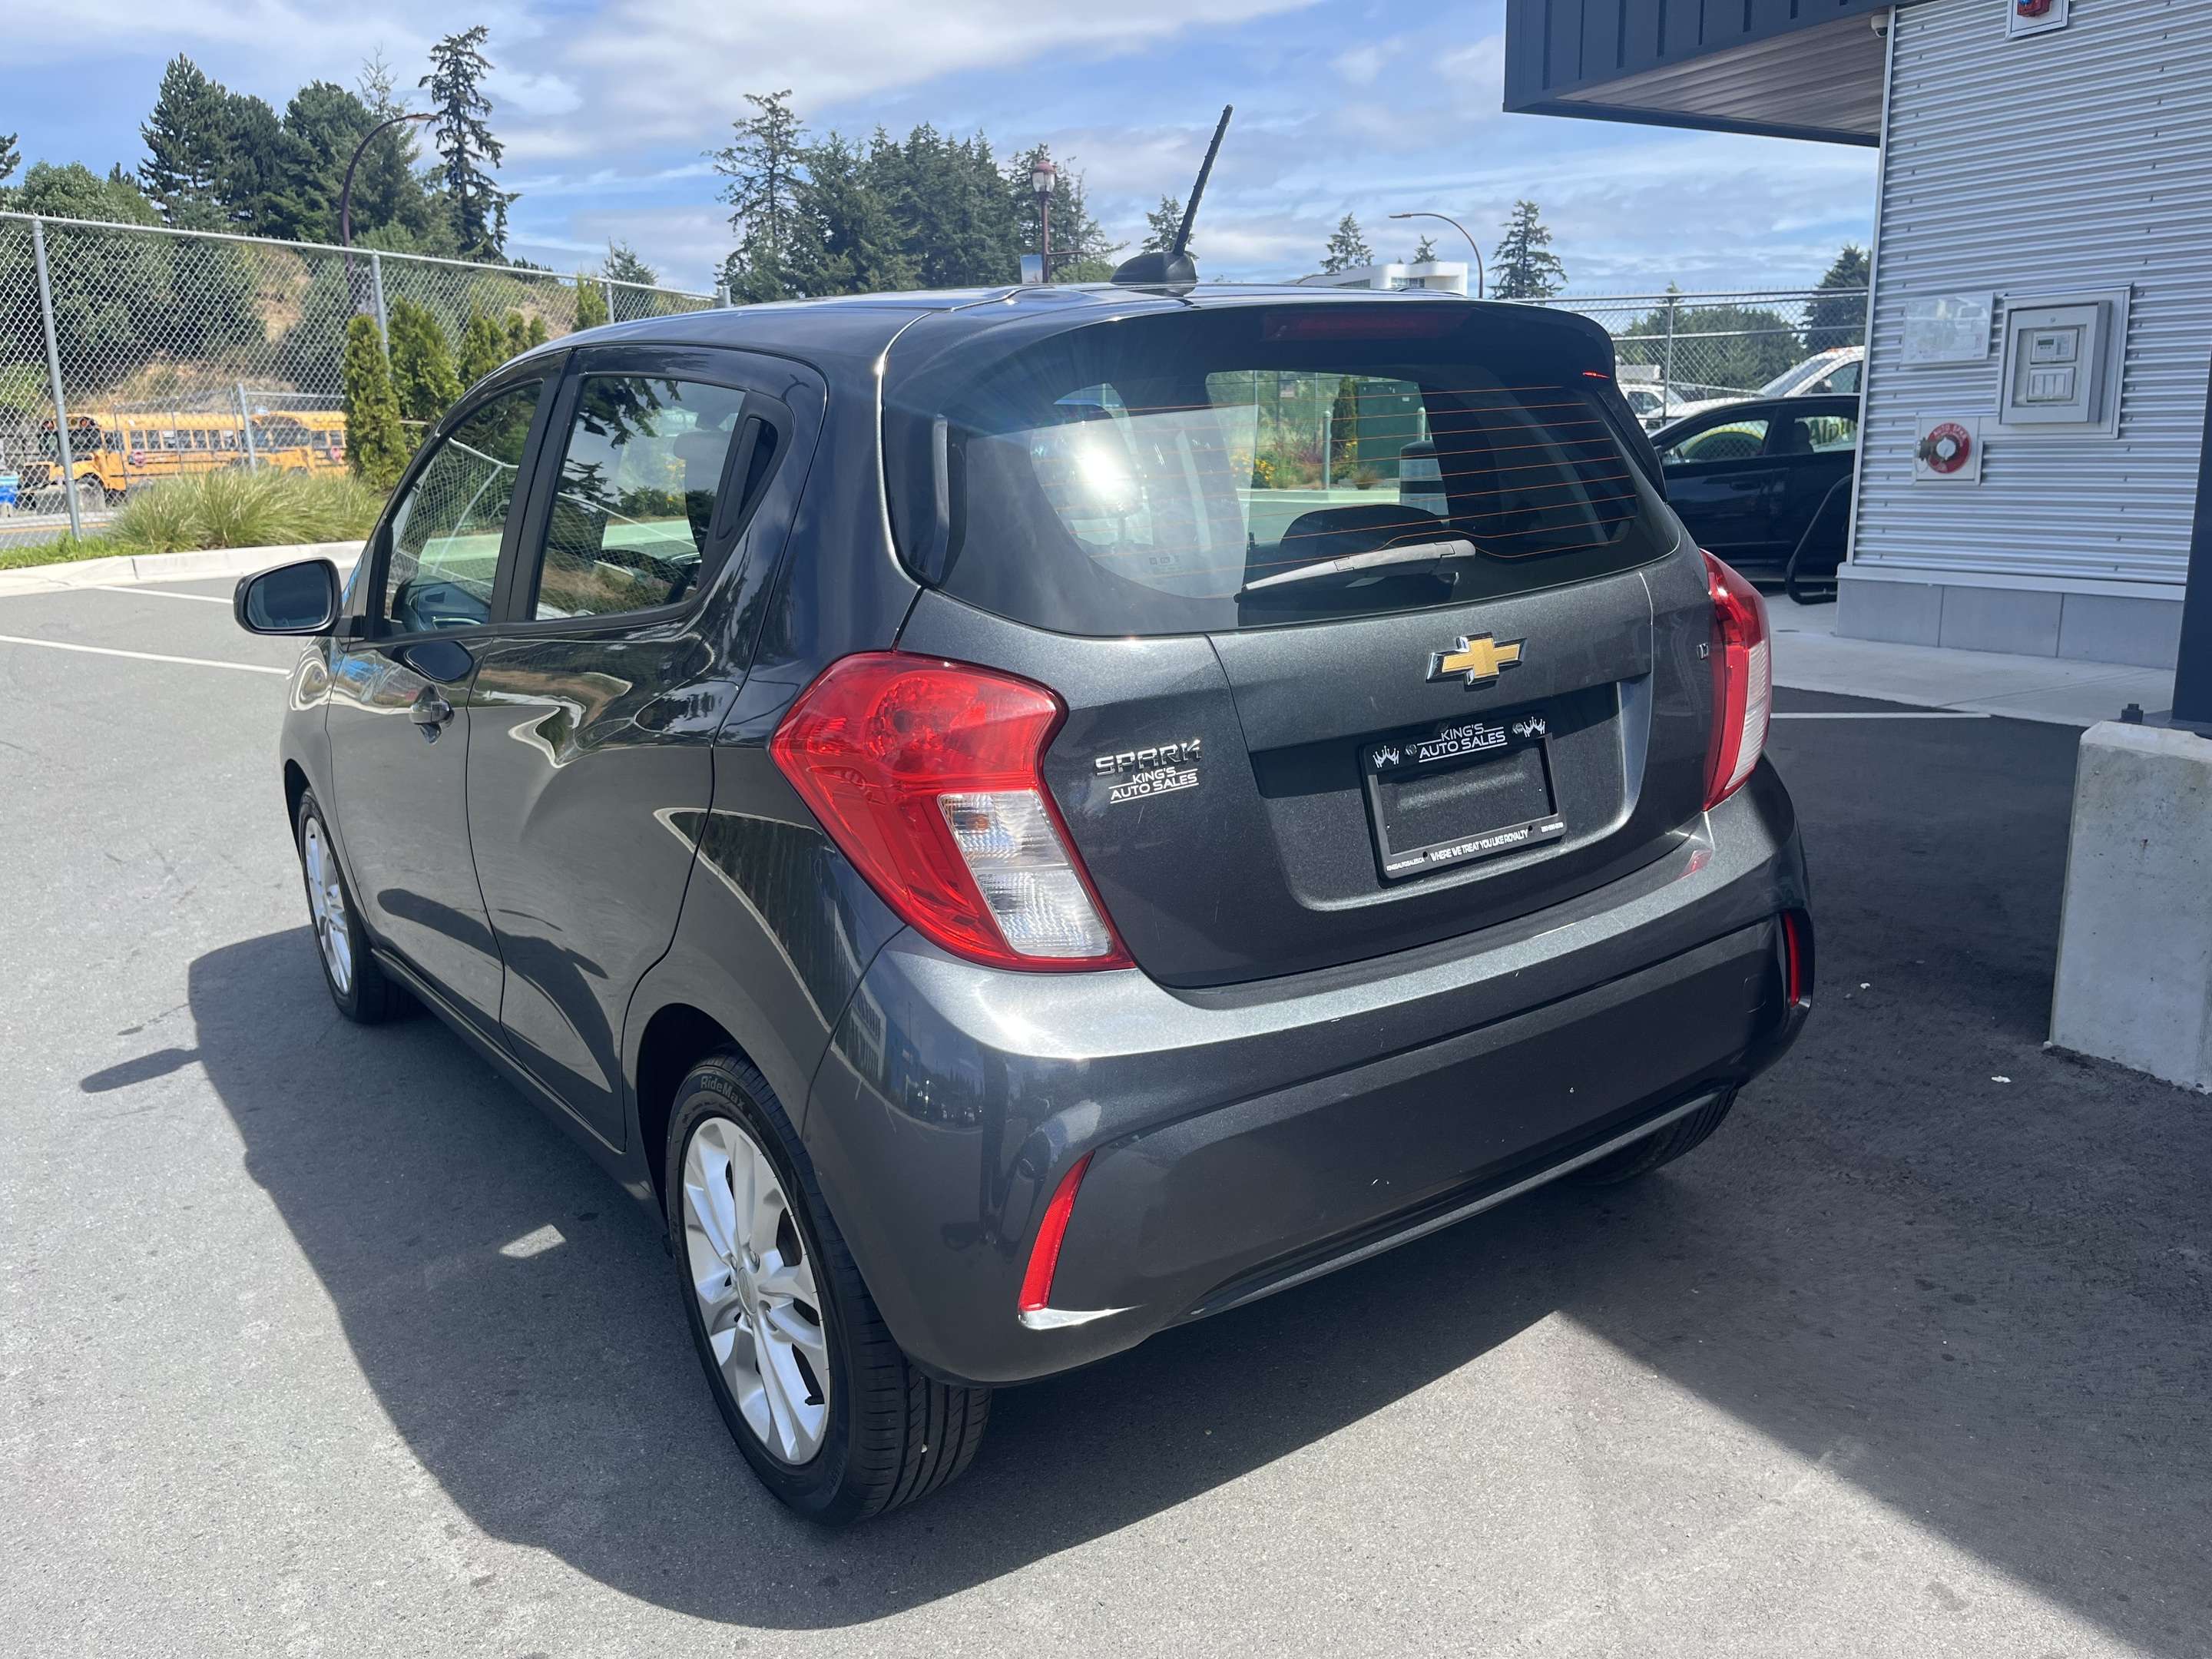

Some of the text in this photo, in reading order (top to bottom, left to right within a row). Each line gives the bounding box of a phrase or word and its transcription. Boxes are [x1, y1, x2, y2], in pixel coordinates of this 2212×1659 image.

[1419, 730, 1506, 759] AUTO SALES
[1441, 723, 1484, 741] KING'S
[1094, 739, 1202, 777] SPARK
[1111, 772, 1197, 800] AUTO SALES
[1132, 766, 1177, 784] KING'S
[1430, 829, 1528, 862] WHERE WE TREAT YOU LIKE ROYALTY
[700, 1075, 746, 1110] RideMax
